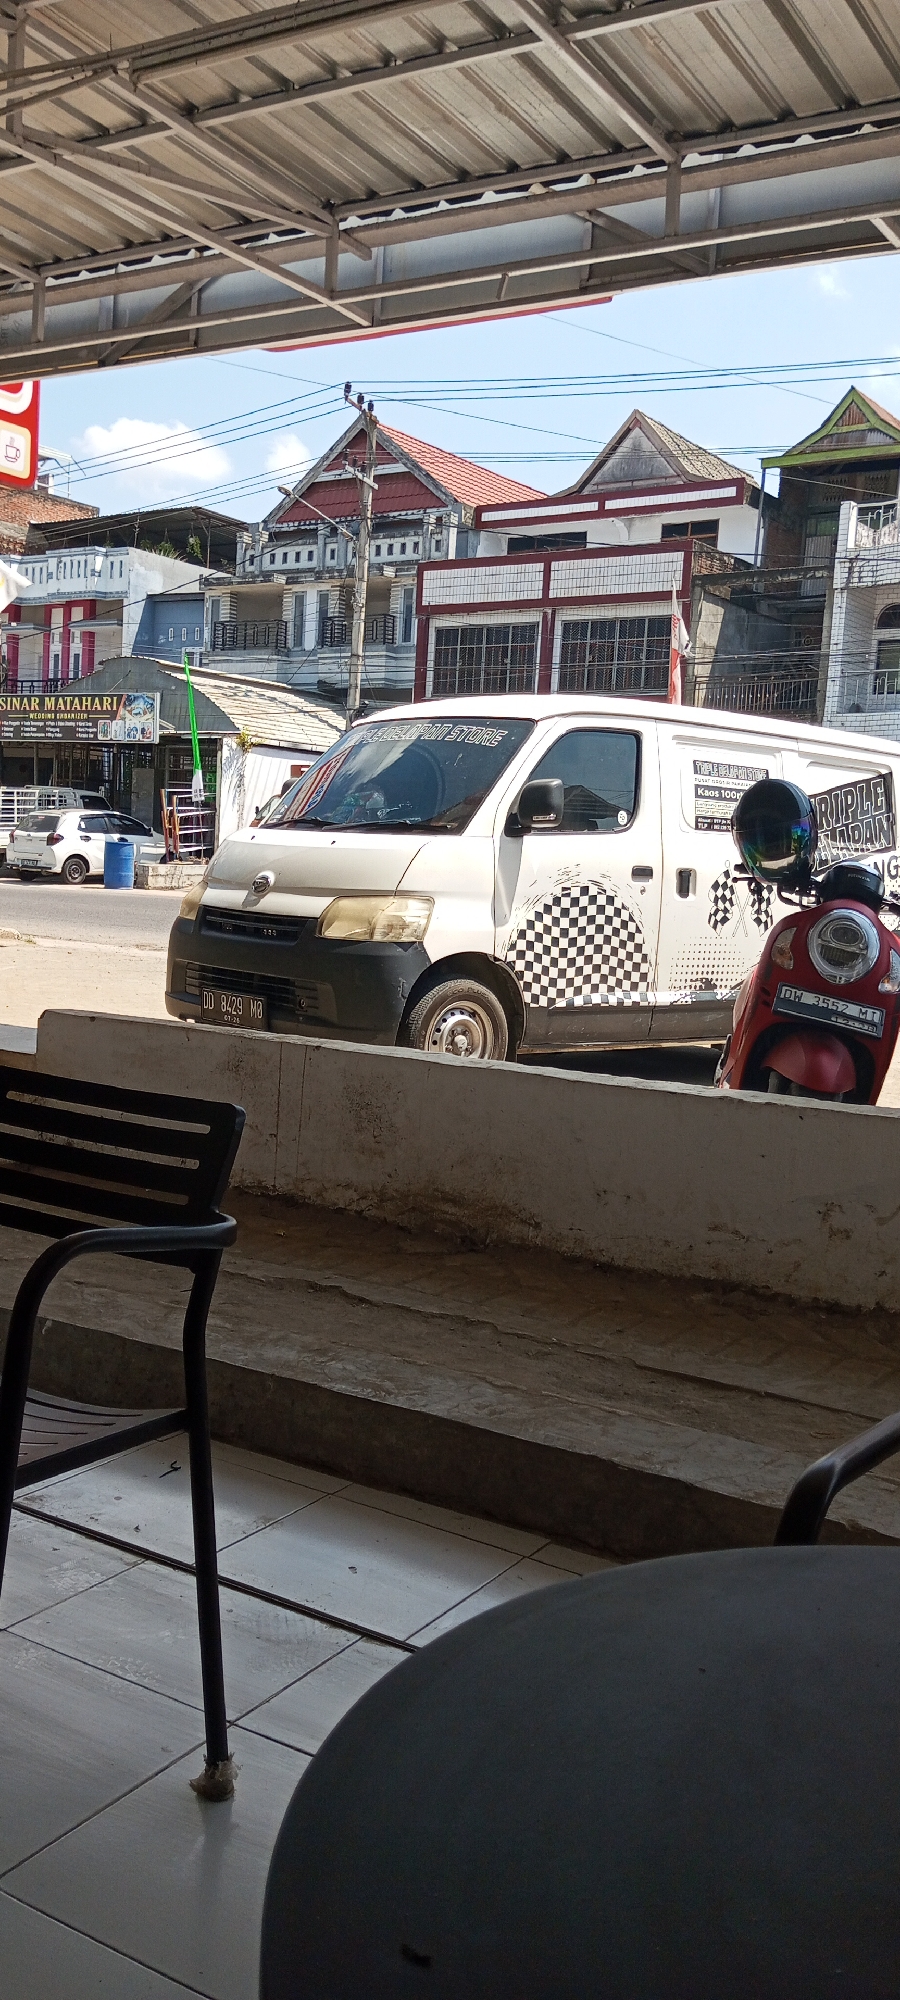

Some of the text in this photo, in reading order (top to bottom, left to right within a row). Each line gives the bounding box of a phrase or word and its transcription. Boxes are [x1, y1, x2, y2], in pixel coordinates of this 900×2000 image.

[0, 696, 118, 711] SINAR MATAHARI
[445, 725, 508, 747] STORE
[695, 761, 718, 777] TRIPLE
[697, 787, 720, 798] Kaos
[812, 812, 893, 872] ELAPAN
[203, 991, 214, 1010] DD
[220, 994, 243, 1015] 8429
[783, 988, 804, 1003] DW
[811, 995, 849, 1012] 3552
